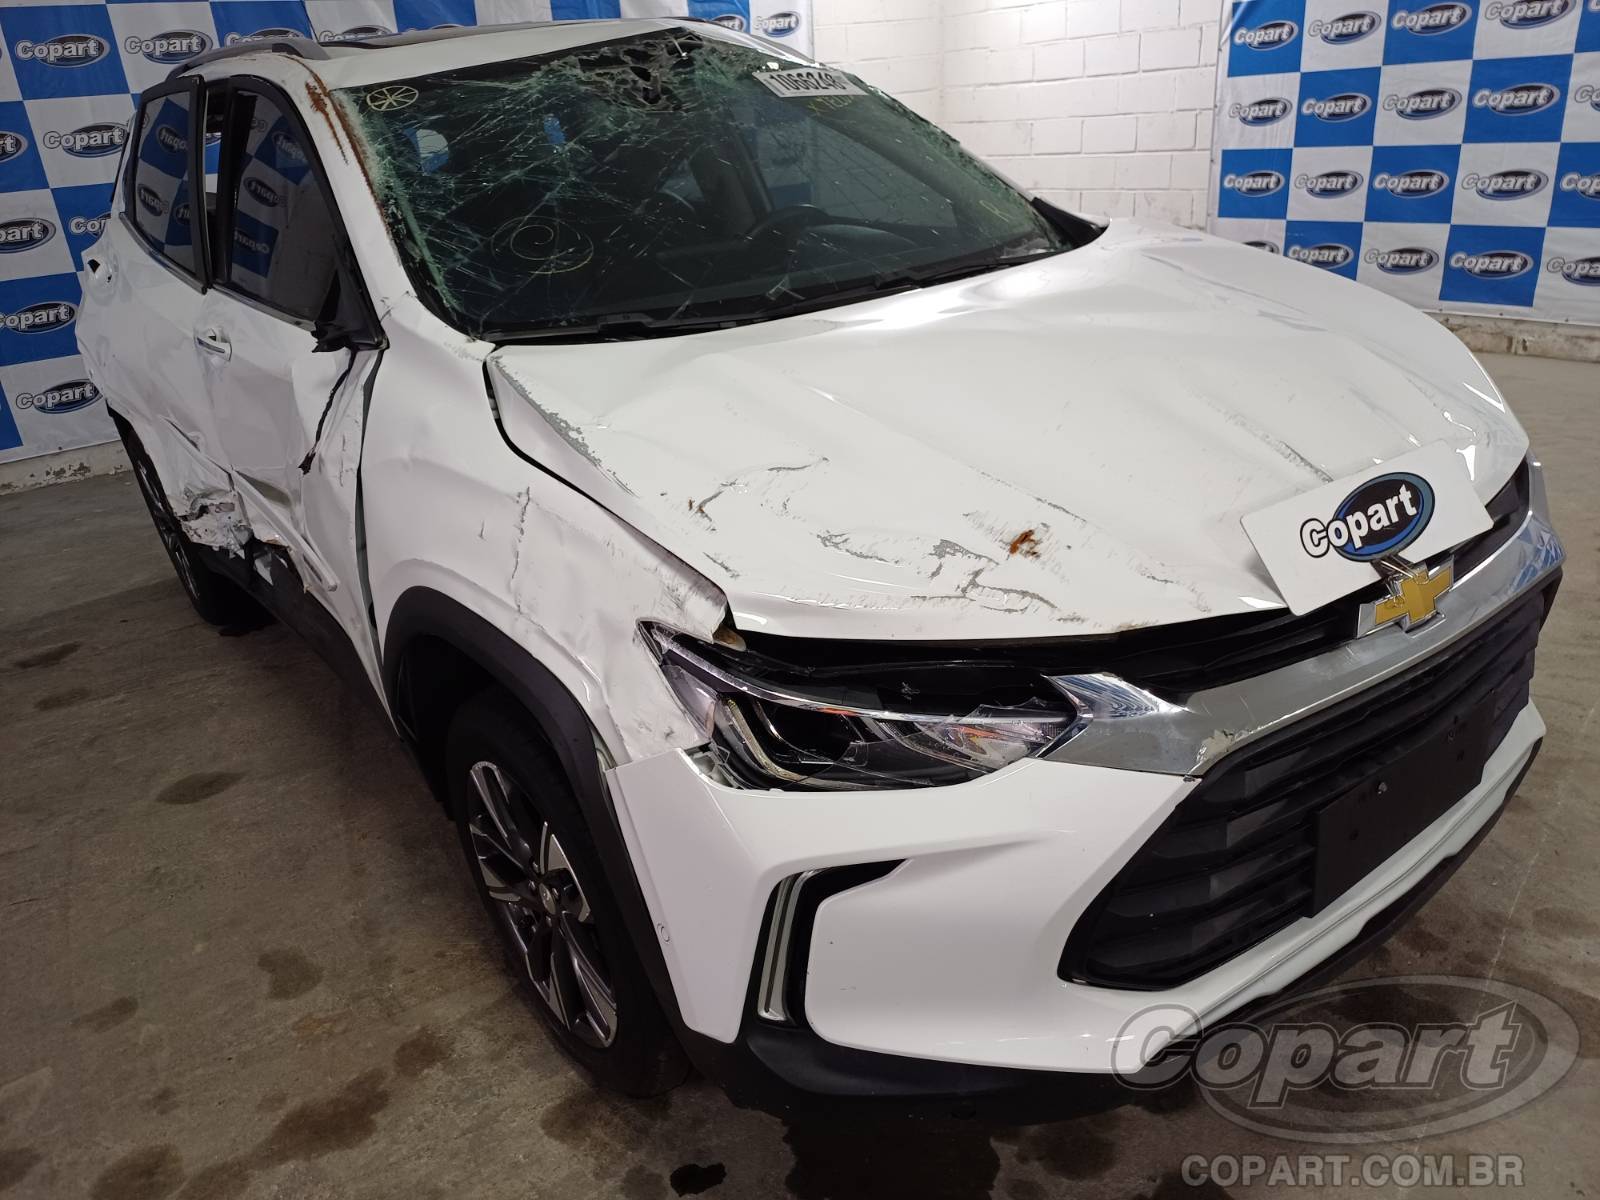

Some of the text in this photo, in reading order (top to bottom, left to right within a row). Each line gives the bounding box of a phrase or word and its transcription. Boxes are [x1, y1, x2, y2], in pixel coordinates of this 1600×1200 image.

[1392, 6, 1464, 31] Copart
[1485, 0, 1563, 23] Copart
[753, 15, 797, 32] Copart
[1234, 22, 1291, 46] Copart
[1308, 14, 1371, 38] Copart
[16, 39, 99, 62] Copart
[124, 34, 200, 56] Copart
[1229, 100, 1283, 121] Copart
[1302, 97, 1364, 117] Copart
[1383, 92, 1450, 113] Copart
[1473, 88, 1551, 112] Copart
[43, 127, 123, 151] Copart
[1223, 173, 1276, 192] Copart
[1295, 173, 1354, 192] Copart
[1374, 173, 1440, 193] Copart
[1462, 172, 1537, 194] Copart
[1288, 245, 1346, 262] Copart
[1364, 249, 1430, 269] Copart
[1450, 252, 1525, 273] Copart
[0, 304, 69, 332] opart
[17, 383, 94, 408] Copart
[1300, 484, 1417, 558] Copart
